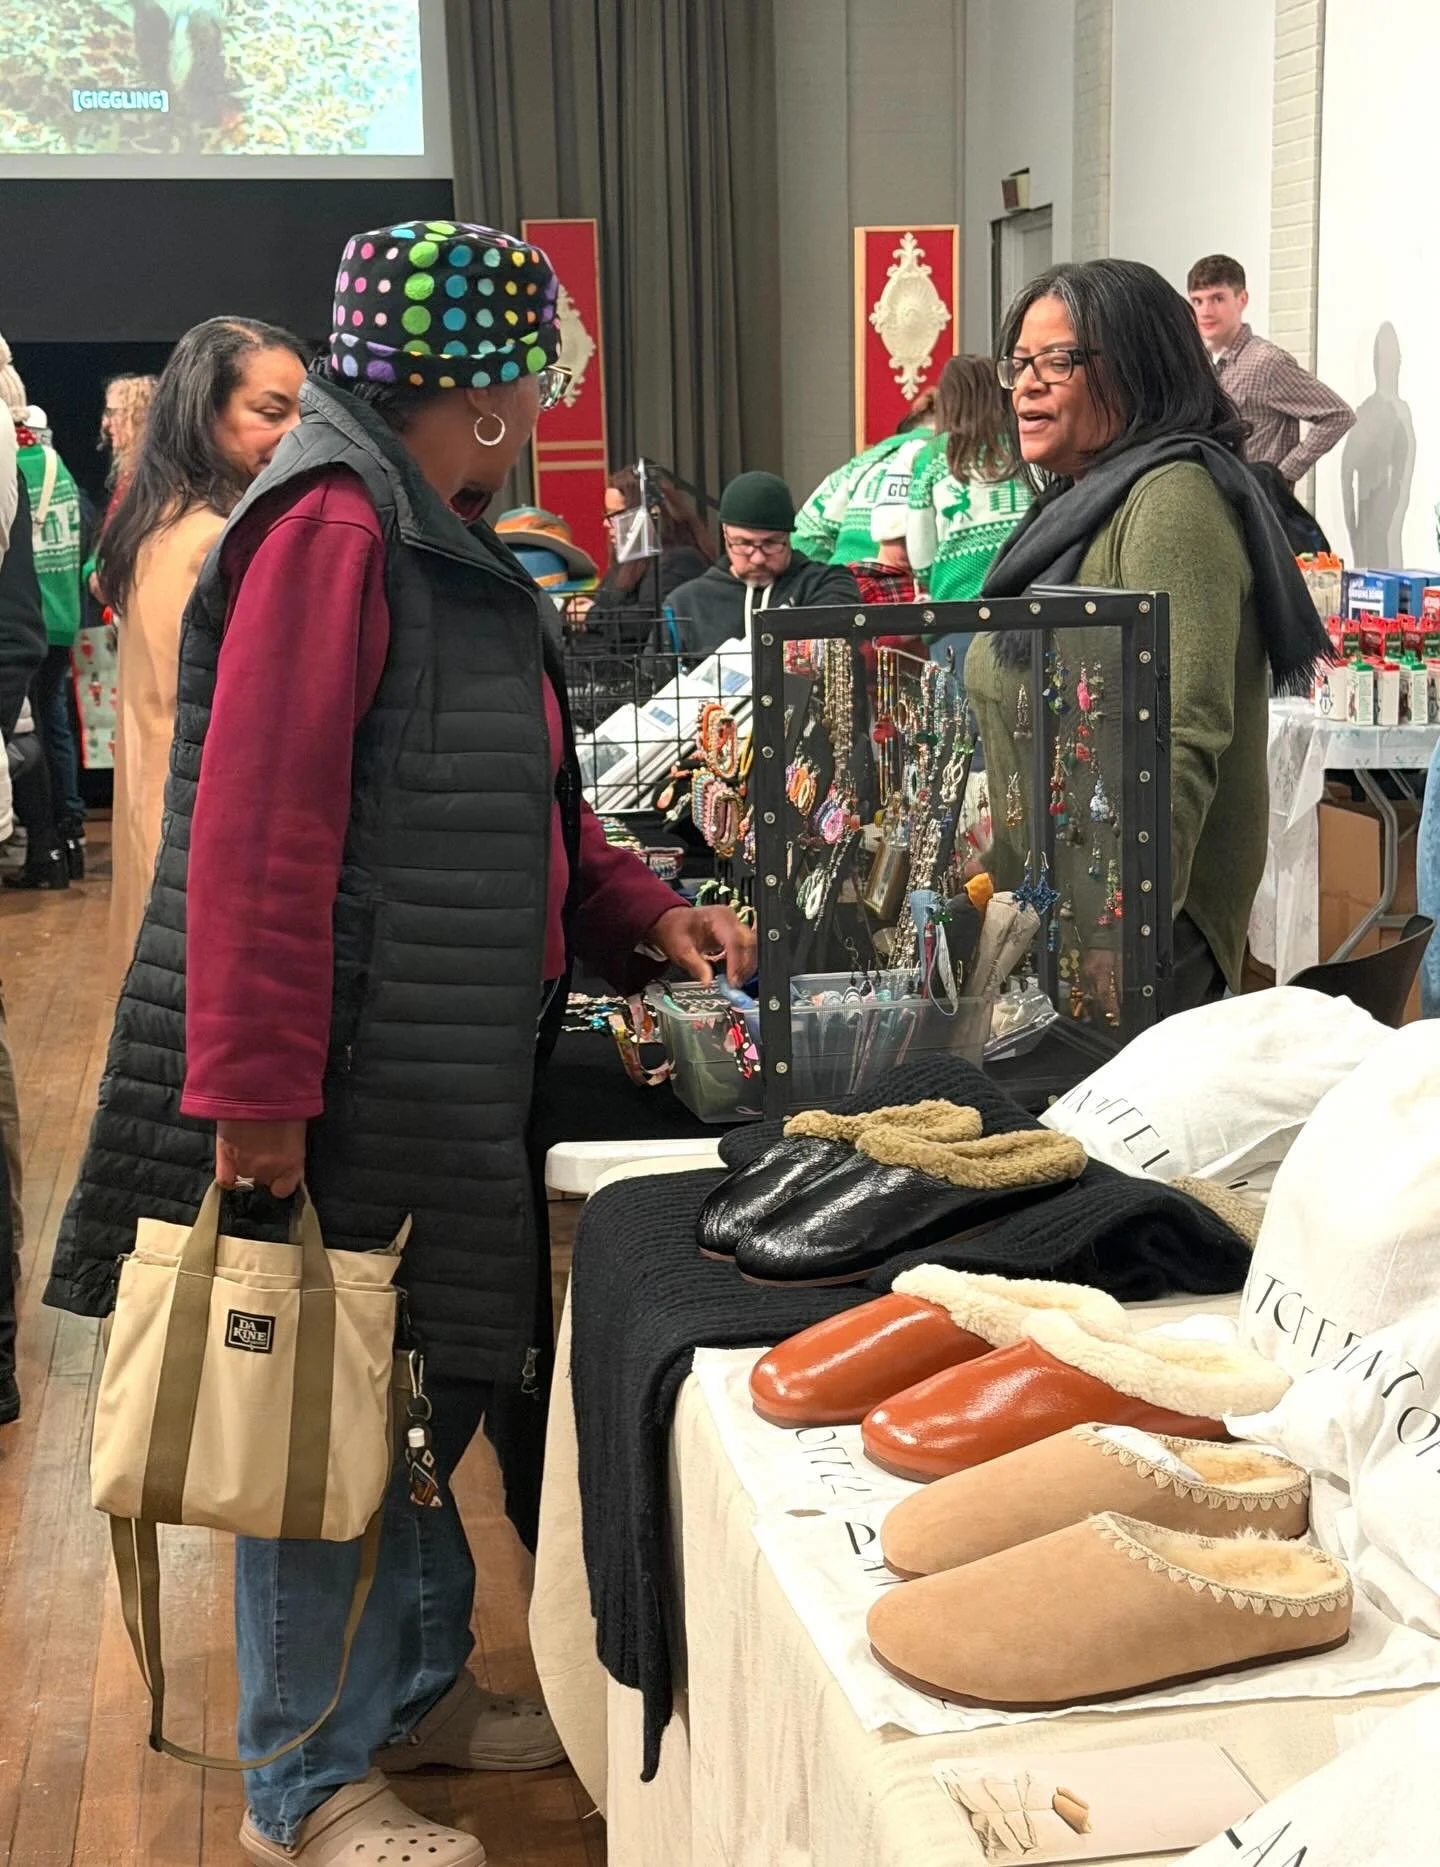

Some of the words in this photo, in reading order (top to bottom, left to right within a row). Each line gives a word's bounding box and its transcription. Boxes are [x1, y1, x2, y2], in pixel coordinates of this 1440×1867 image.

[72, 89, 169, 112] [GIGGLING]
[239, 1319, 257, 1332] DA
[233, 1327, 267, 1343] KINE
